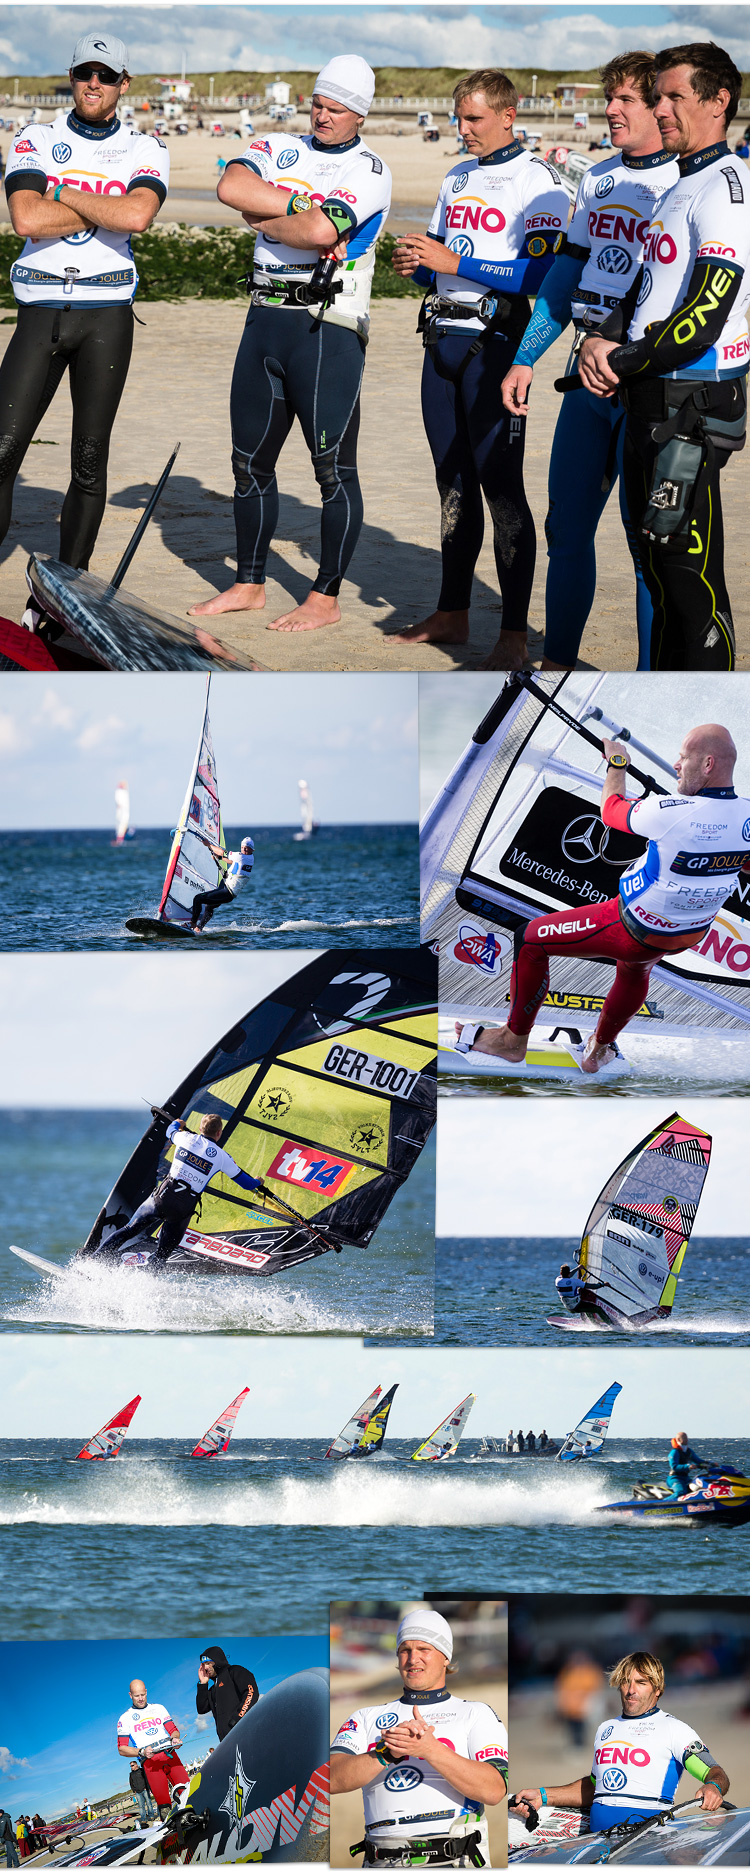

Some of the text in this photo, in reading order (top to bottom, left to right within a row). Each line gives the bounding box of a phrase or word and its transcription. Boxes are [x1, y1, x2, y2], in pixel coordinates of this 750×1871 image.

[693, 149, 719, 165] GP JOULE
[445, 205, 506, 233] RENO
[525, 217, 562, 231] RENO
[16, 268, 28, 277] GP
[480, 263, 514, 277] INFINITI
[548, 703, 581, 731] NEILPRYDE
[690, 822, 728, 831] FREEDOM
[687, 854, 750, 869] GP JOULE
[506, 847, 613, 904] Mercedes-Ben
[687, 895, 725, 905] SPORT
[634, 905, 680, 928] RENO
[537, 917, 596, 938] O'NEILL
[461, 939, 494, 963] PWA
[324, 1045, 419, 1097] GER-1001
[350, 1142, 371, 1153] SYLT
[179, 1149, 208, 1169] GP JOULE
[276, 1148, 345, 1189] tv14
[611, 1208, 664, 1239] GER-179
[134, 1718, 161, 1732] RENO
[595, 1747, 651, 1767] RENO
